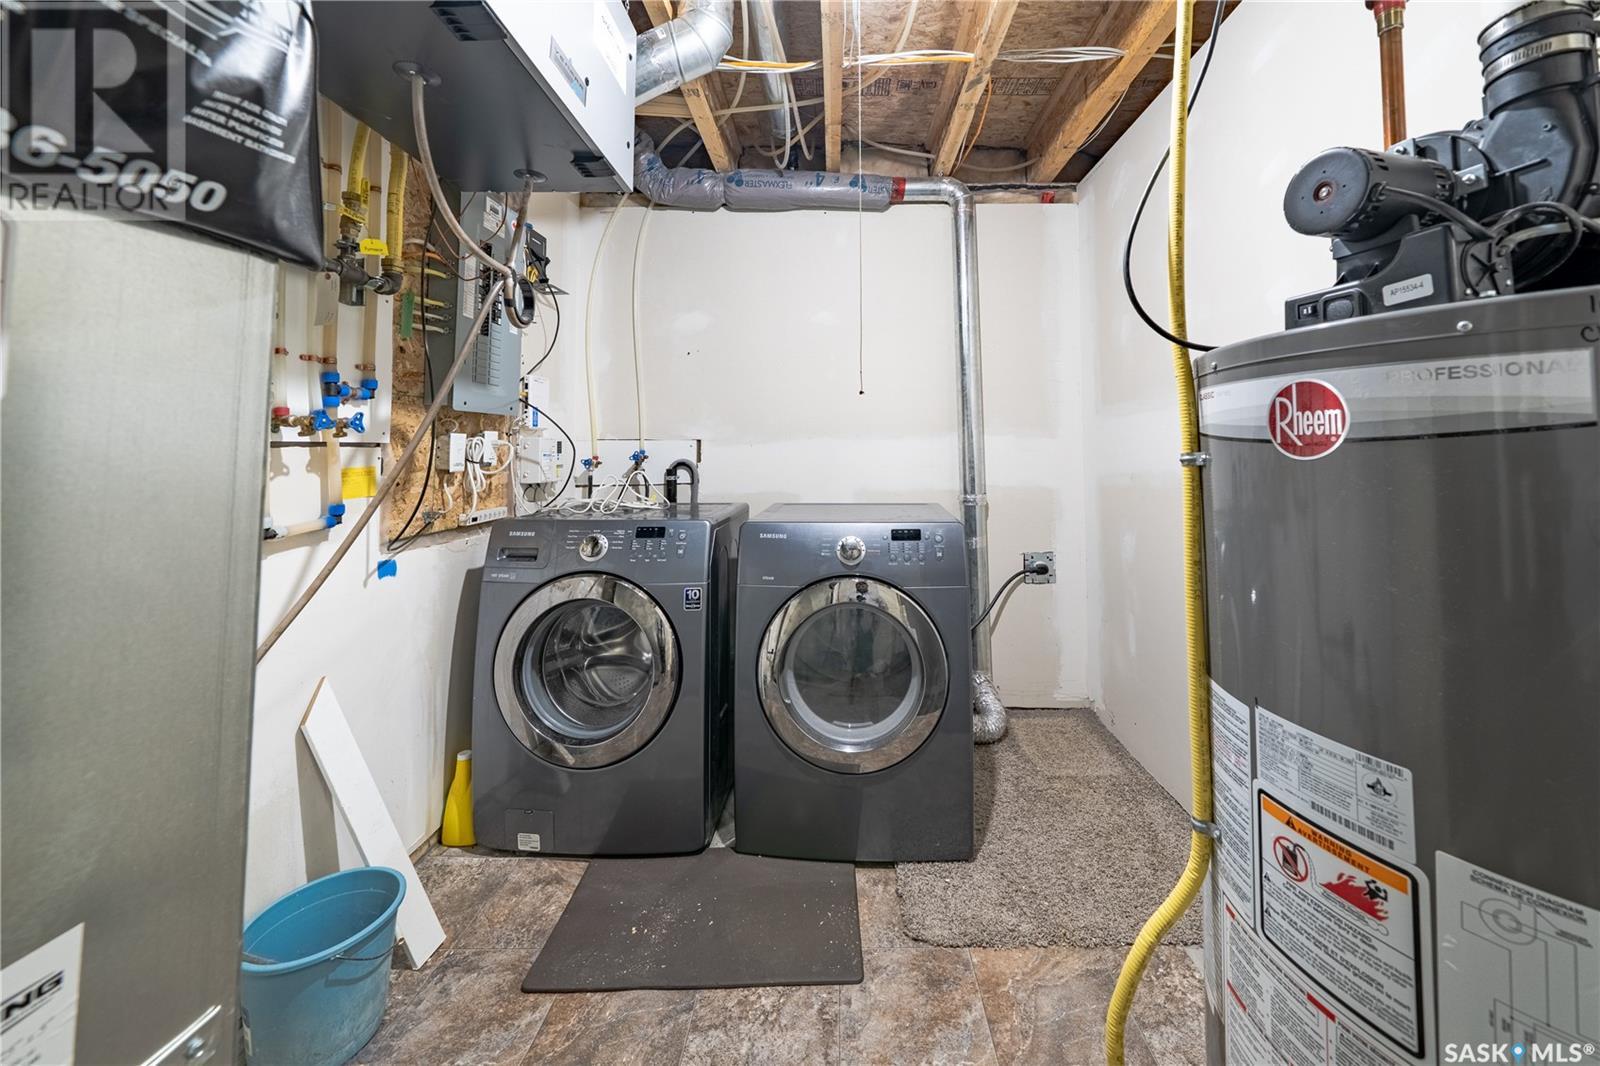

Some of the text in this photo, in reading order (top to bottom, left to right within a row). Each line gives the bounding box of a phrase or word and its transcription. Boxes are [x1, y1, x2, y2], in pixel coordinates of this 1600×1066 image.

[744, 180, 794, 190] FLEXMASTER
[1275, 383, 1342, 446] Rheem
[686, 589, 700, 601] 10
[1298, 827, 1370, 874] AVERTISSEMENT
[1311, 828, 1352, 858] WARNING
